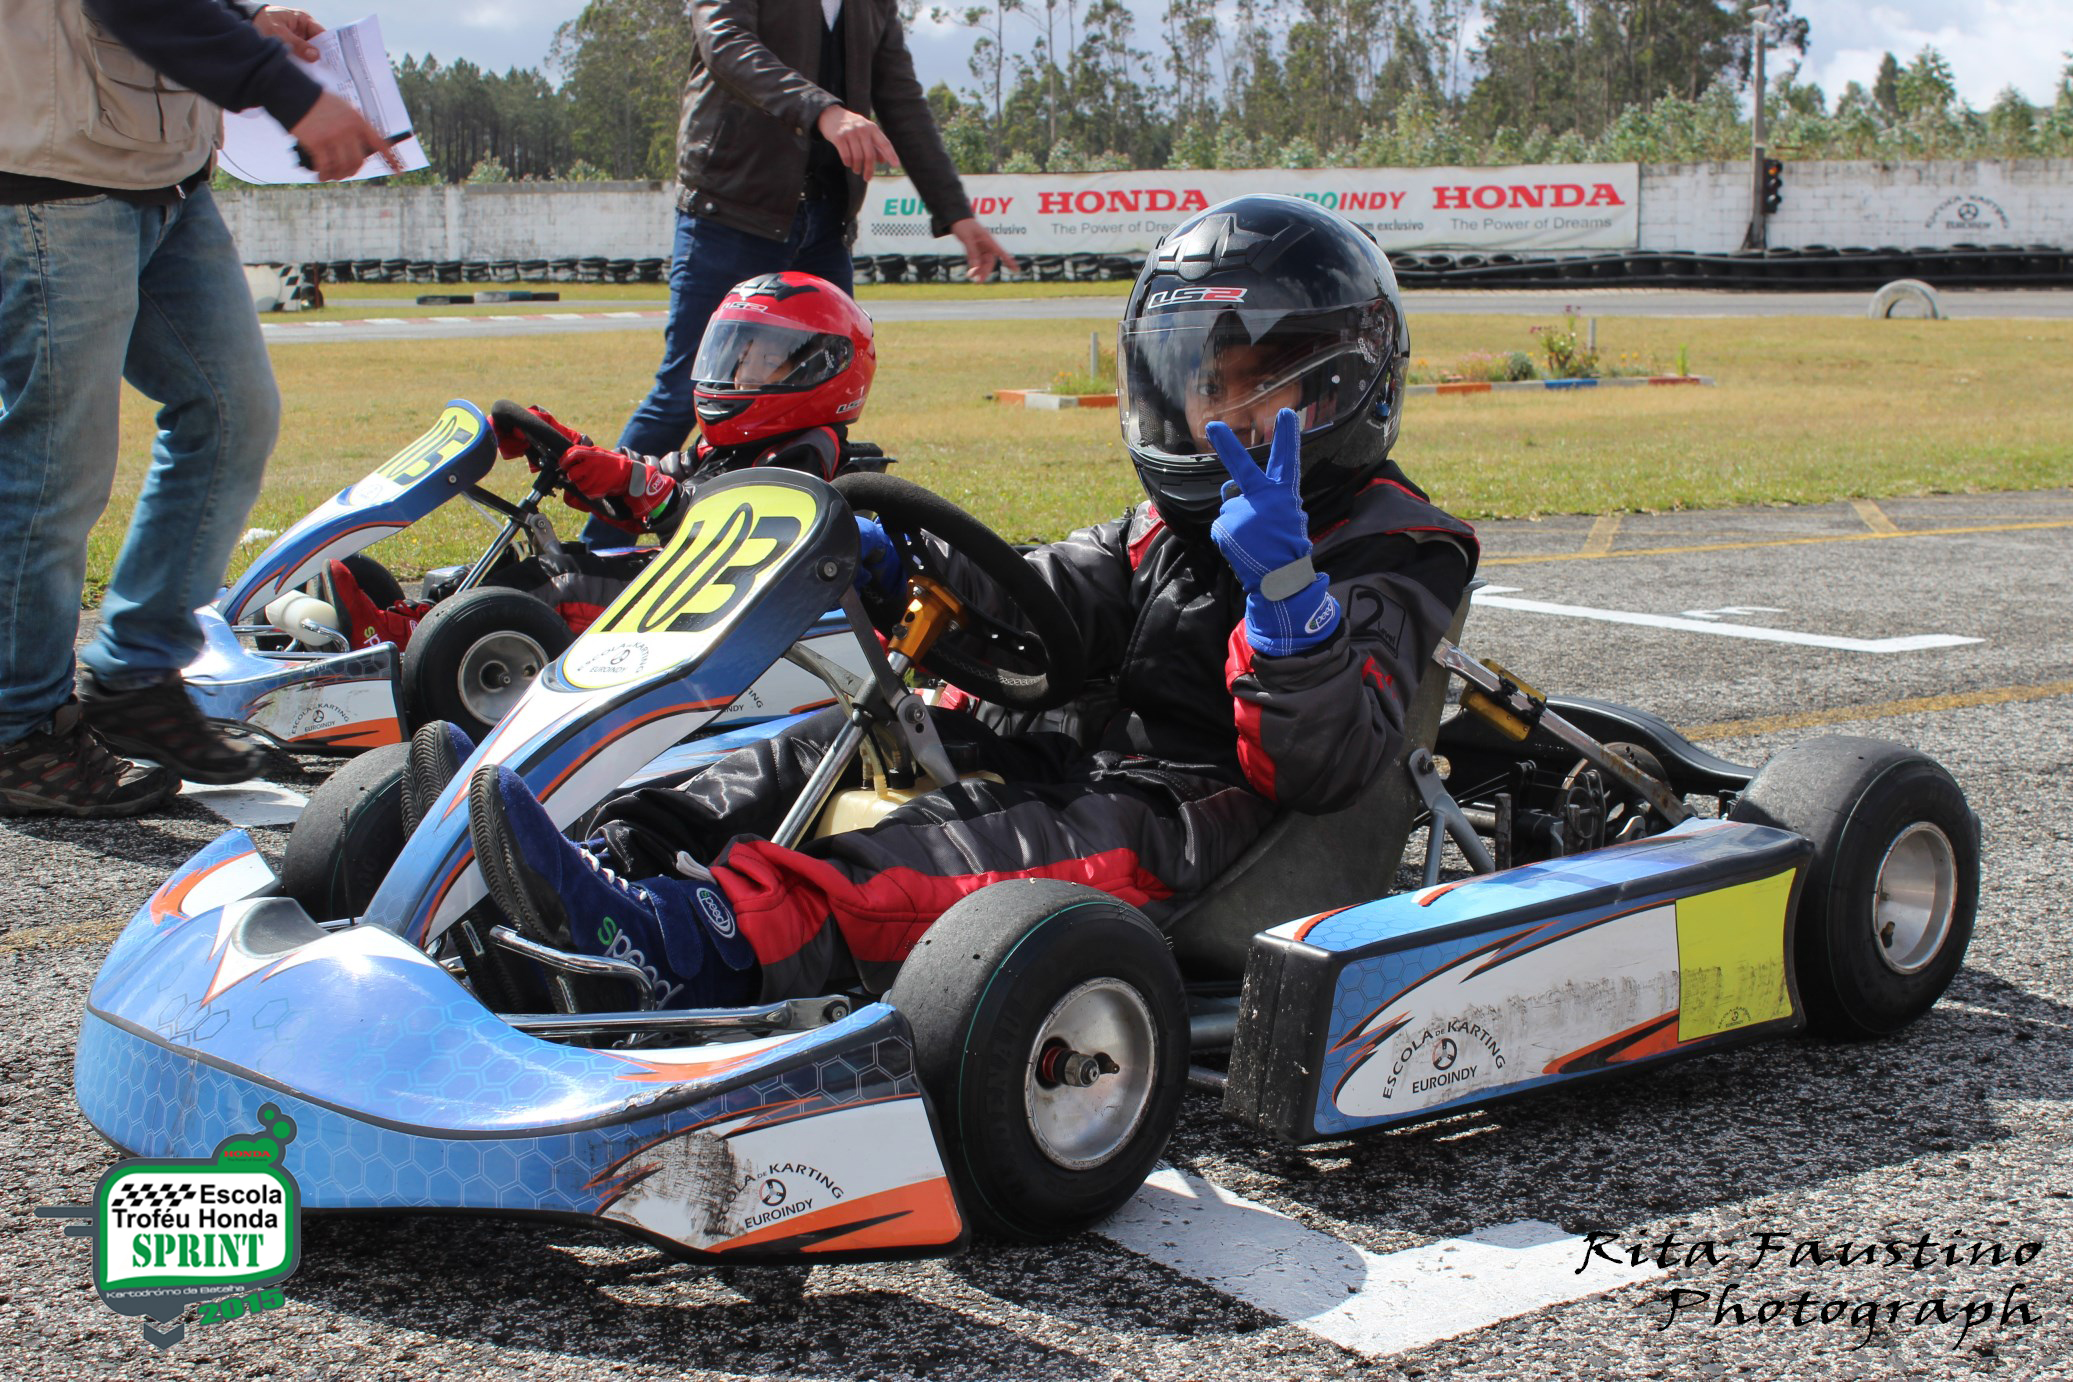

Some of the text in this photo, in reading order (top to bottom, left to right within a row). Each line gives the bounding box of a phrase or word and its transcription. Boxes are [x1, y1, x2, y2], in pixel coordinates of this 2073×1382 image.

[1038, 189, 1209, 214] HONDA
[1287, 191, 1407, 210] ROINDY
[1432, 183, 1626, 210] HONDA
[987, 222, 1028, 235] xclusivo
[1052, 220, 1179, 235] The Power of Drea
[1377, 218, 1424, 232] exclusivo
[1451, 216, 1613, 230] The Power of Dreams
[1148, 286, 1248, 309] LS2
[600, 502, 802, 633] 103
[1351, 591, 1384, 636] 2
[291, 703, 350, 735] ESCOLA KARTING
[304, 720, 336, 732] EUROINDY
[1382, 1030, 1433, 1099] ESCOLA
[1447, 1021, 1506, 1070] KARTING
[1411, 1065, 1478, 1094] EUROINDY
[769, 1163, 844, 1200] KARTING
[744, 1198, 813, 1229] EUROINDY
